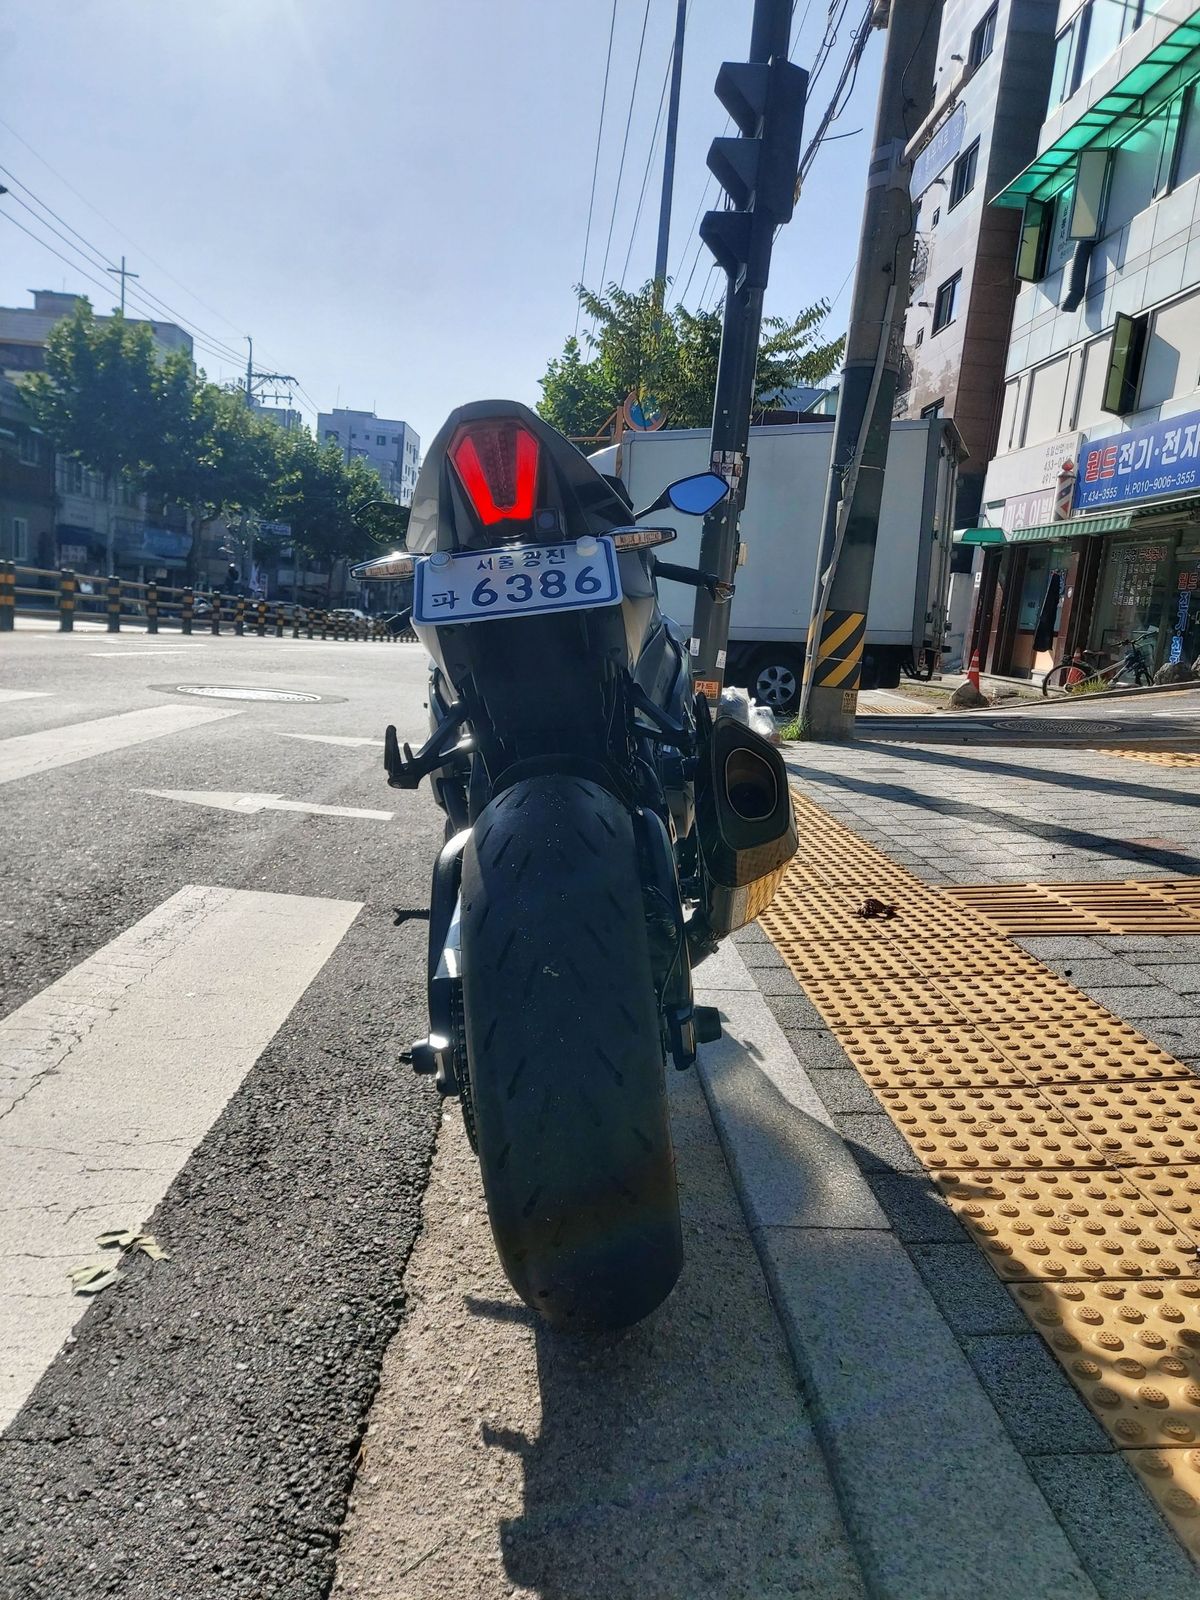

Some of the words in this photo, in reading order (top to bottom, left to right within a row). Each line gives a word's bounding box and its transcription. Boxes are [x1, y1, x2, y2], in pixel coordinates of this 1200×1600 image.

[477, 556, 514, 570] 서울
[523, 549, 566, 567] 광진
[432, 590, 459, 609] 파
[471, 566, 602, 607] 6386
